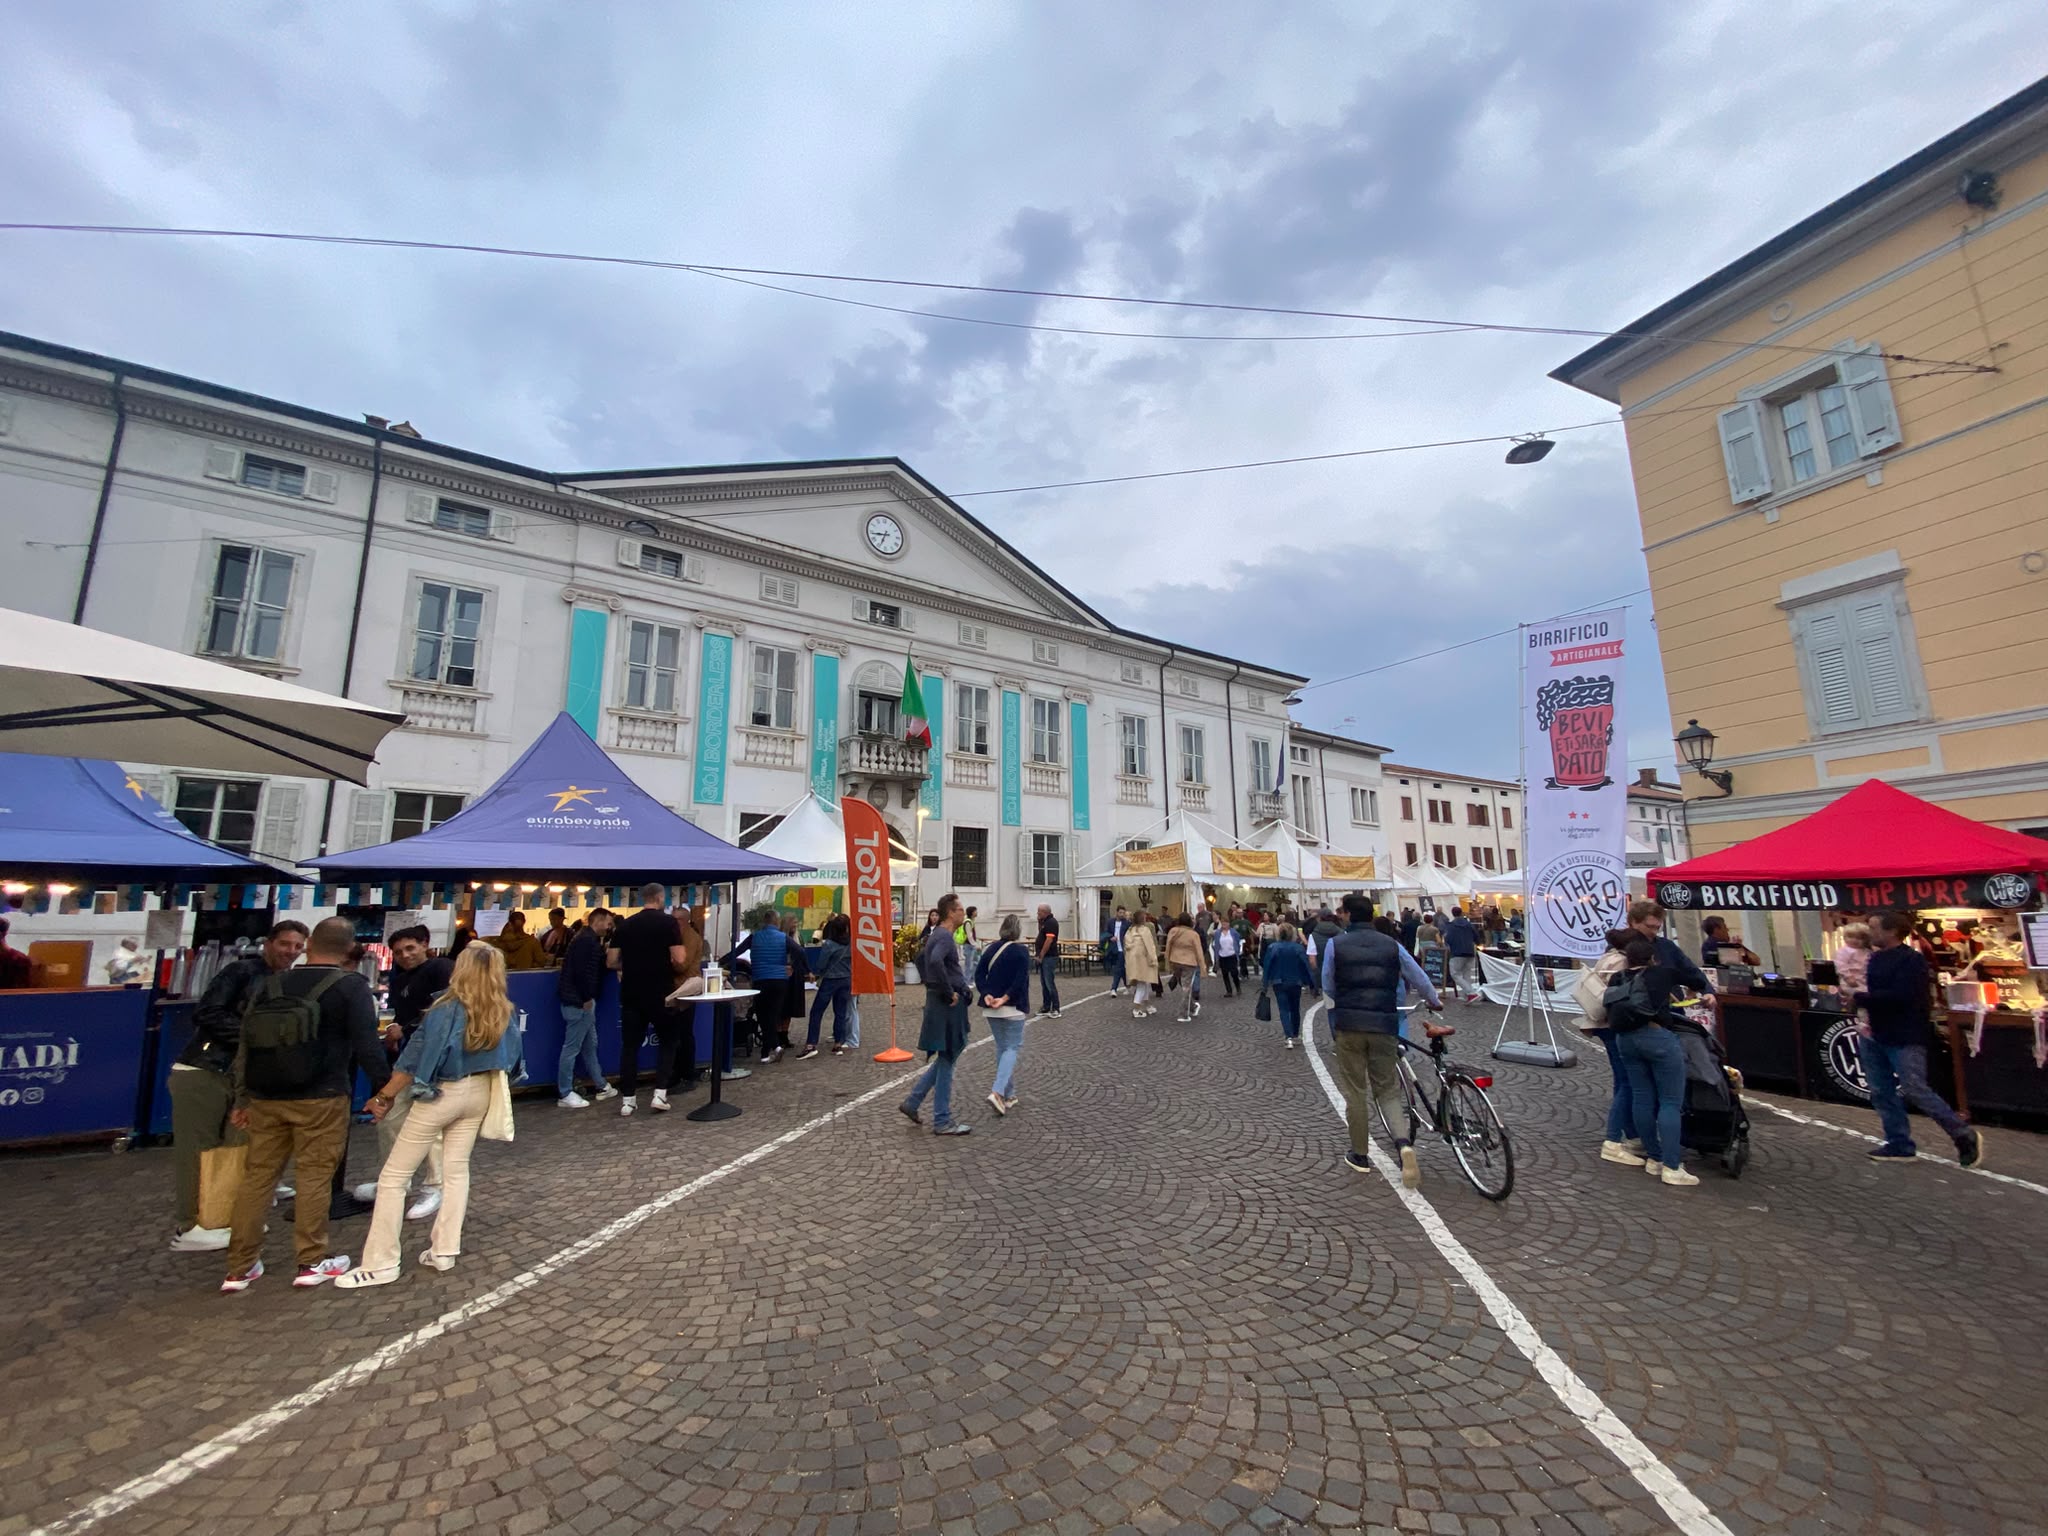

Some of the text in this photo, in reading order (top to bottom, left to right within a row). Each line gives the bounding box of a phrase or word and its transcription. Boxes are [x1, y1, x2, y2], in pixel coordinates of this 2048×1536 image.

[1529, 621, 1609, 649] BIRRIFICIO
[1556, 644, 1619, 662] ARTIGIANALE
[1558, 750, 1603, 775] DATO
[526, 816, 631, 827] eurobevande
[800, 869, 848, 880] GORIZIA
[1536, 866, 1562, 897] BREWERY
[1567, 854, 1612, 867] DISTILLERY
[854, 830, 886, 972] APEROL
[1582, 918, 1615, 938] BEER
